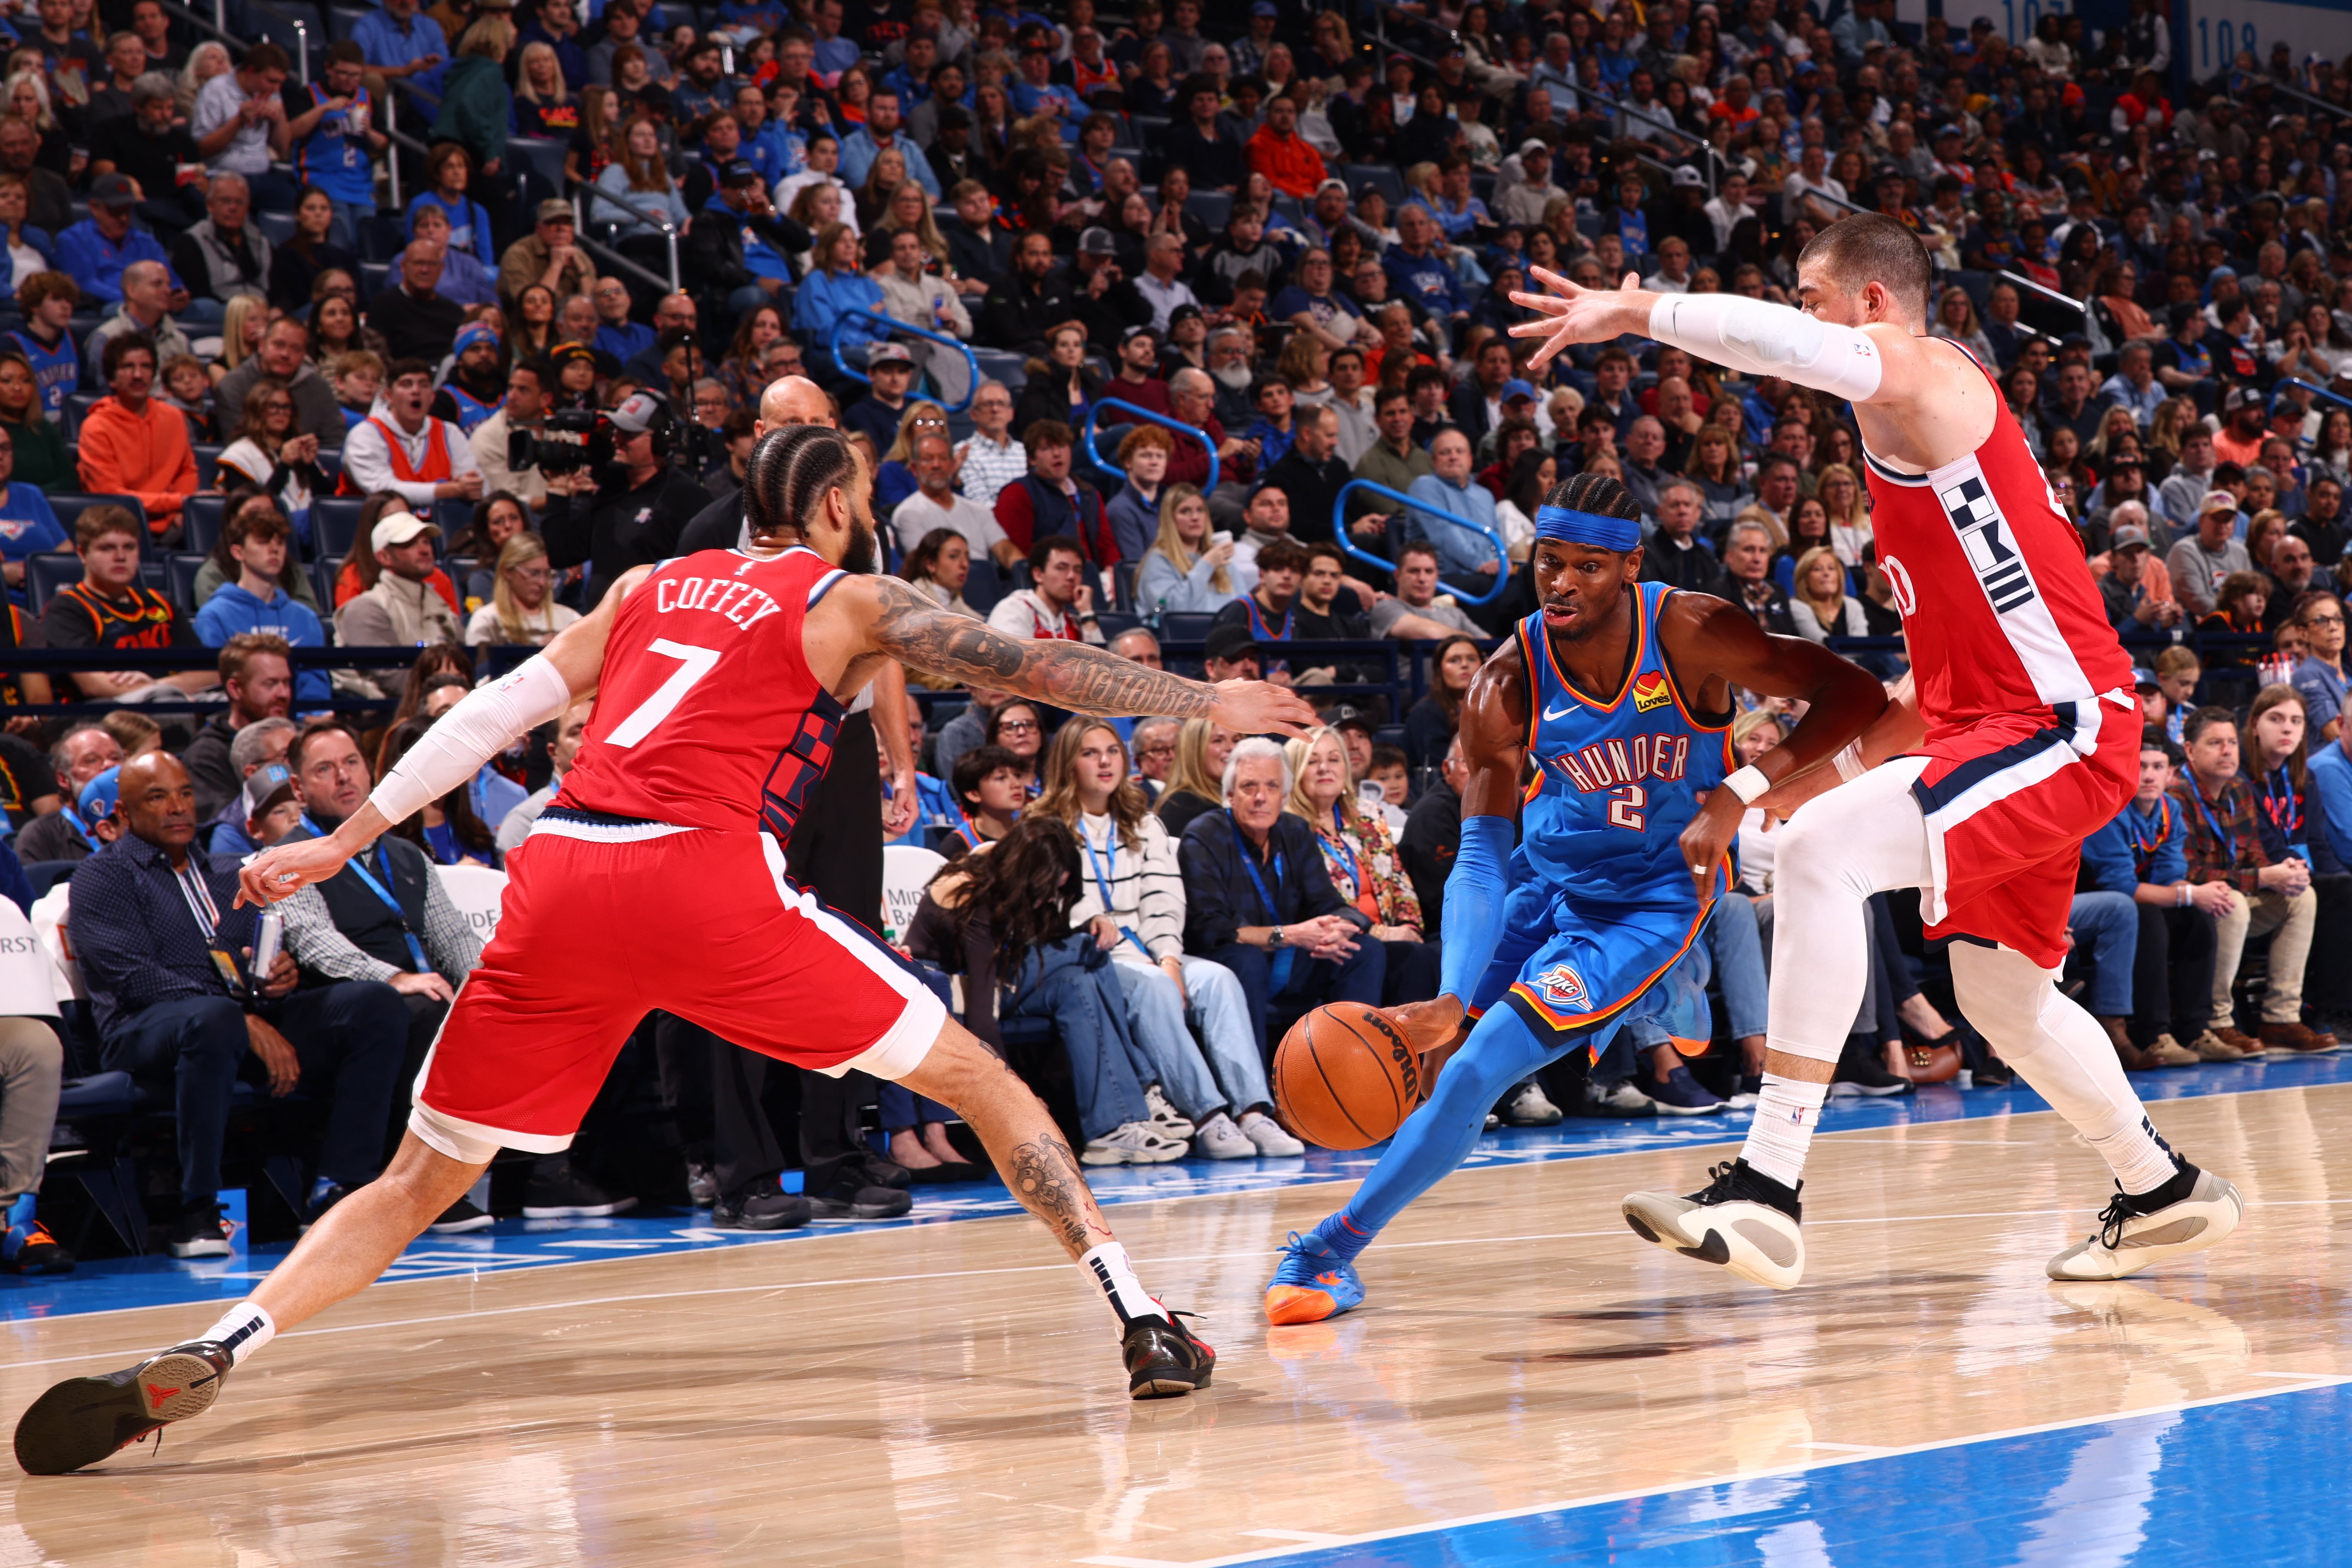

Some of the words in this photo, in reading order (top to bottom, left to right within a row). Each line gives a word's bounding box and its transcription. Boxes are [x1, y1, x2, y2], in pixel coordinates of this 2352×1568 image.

[658, 577, 782, 631] COFFEY
[603, 637, 723, 748] 7
[1607, 784, 1647, 833] 2
[1540, 974, 1579, 994] OKC
[1362, 1011, 1418, 1104] Wilson
